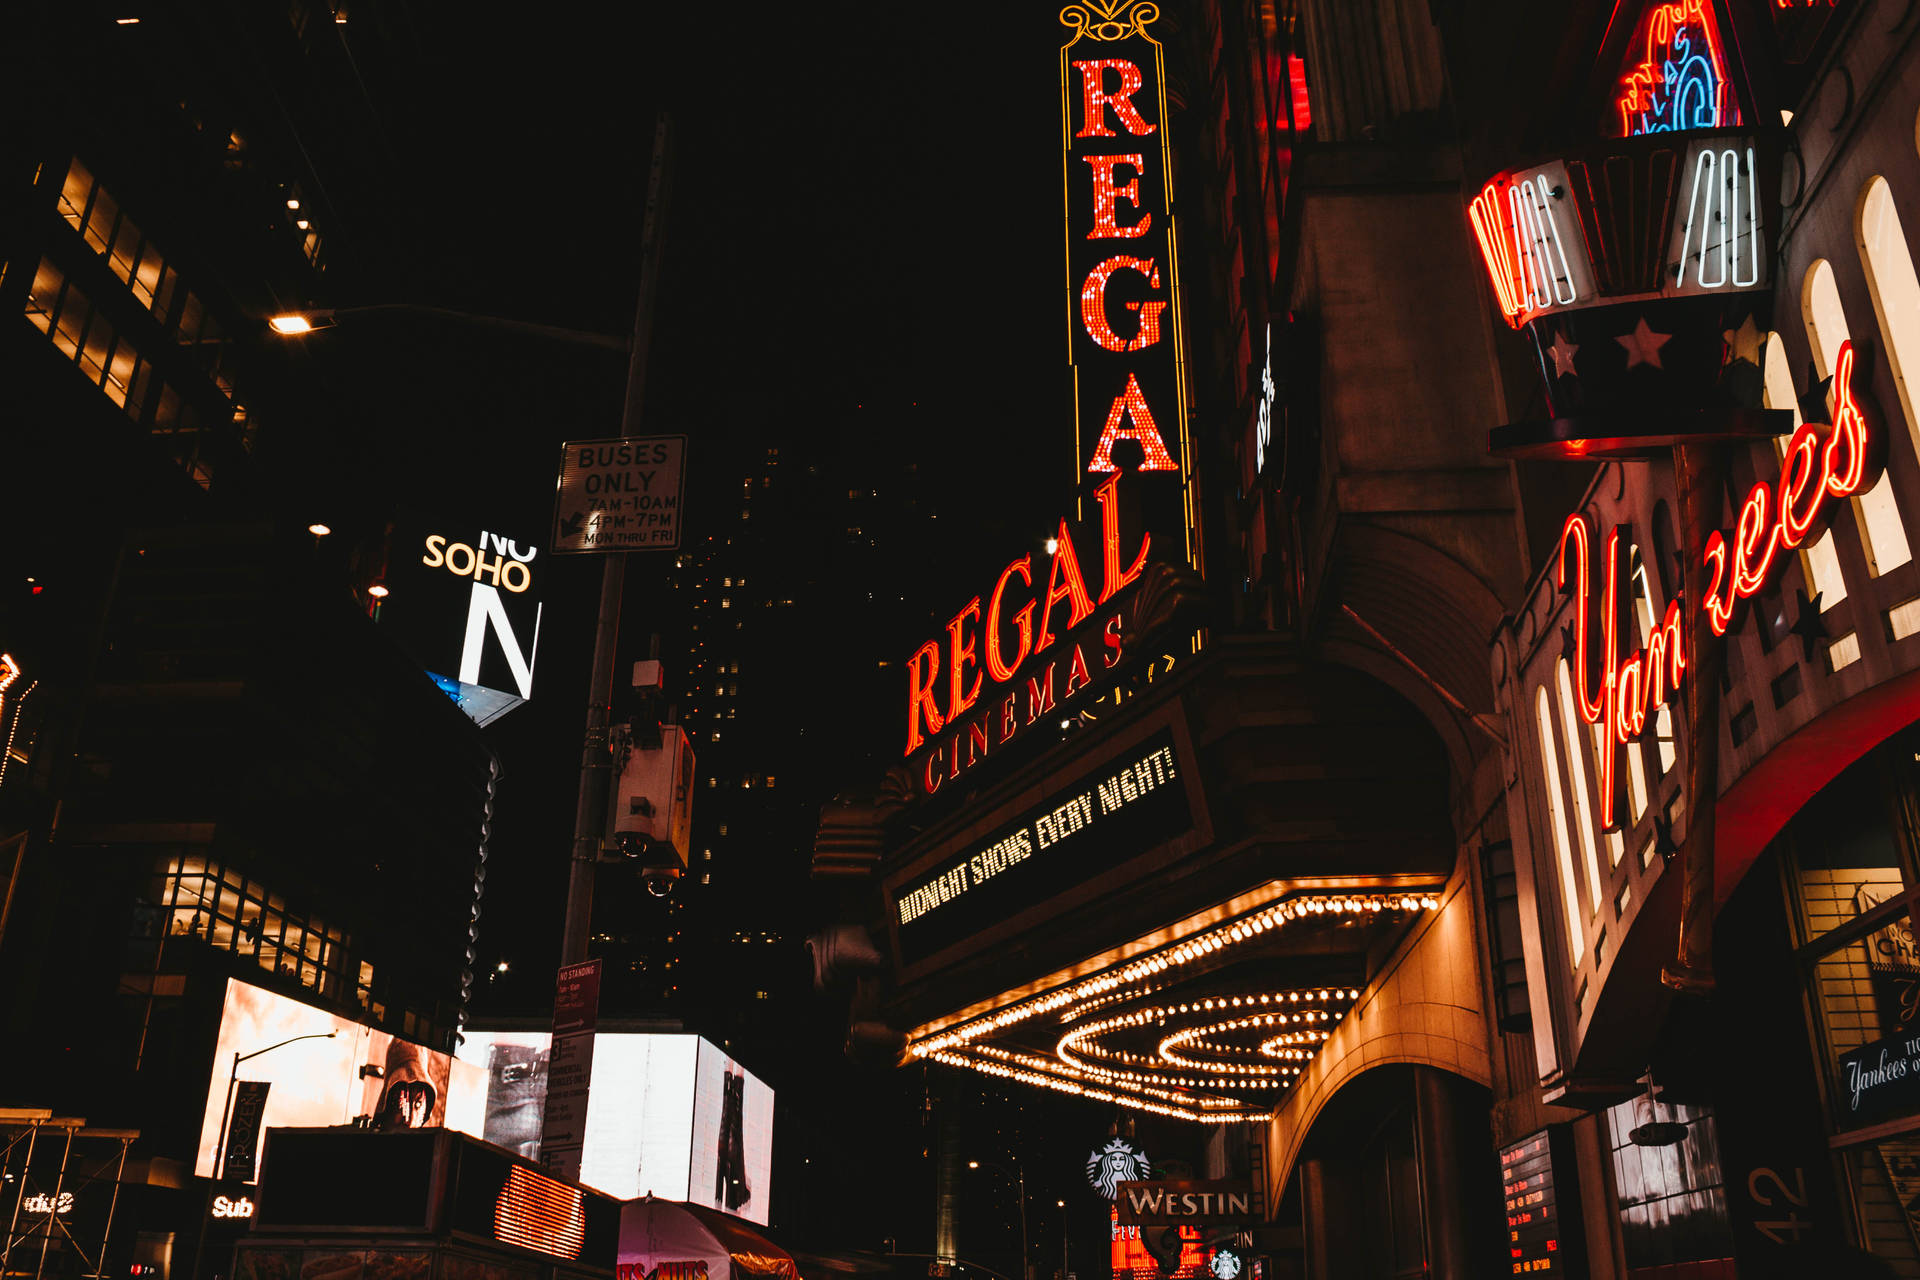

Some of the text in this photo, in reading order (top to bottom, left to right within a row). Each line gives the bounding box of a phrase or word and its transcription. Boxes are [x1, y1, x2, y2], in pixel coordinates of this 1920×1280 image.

[578, 444, 668, 468] BUSES
[585, 471, 656, 494] ONLY
[588, 496, 676, 511] 7AM-10AM
[589, 513, 671, 529] 4PM-7PM
[584, 530, 673, 545] MON THRU FRI
[422, 534, 531, 593] SOHO
[904, 467, 1151, 757] REGAL
[925, 613, 1122, 794] CINEMAS
[898, 745, 1176, 926] MIDNIGHT SHOWS EVERY NIGHT!
[1846, 1048, 1907, 1111] Yankees
[212, 1195, 255, 1218] Sub
[1126, 1187, 1249, 1216] WESTIN
